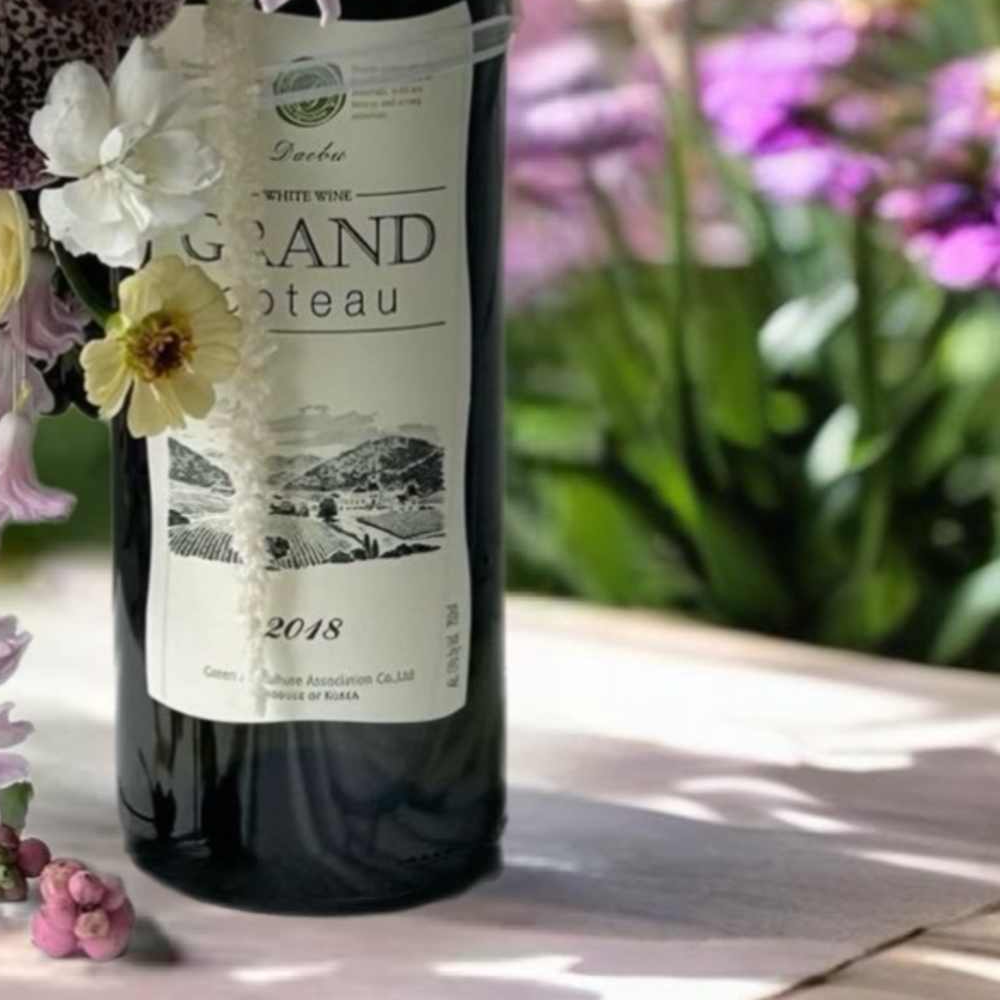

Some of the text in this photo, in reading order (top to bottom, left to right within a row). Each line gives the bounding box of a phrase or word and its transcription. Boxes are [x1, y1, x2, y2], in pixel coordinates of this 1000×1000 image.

[263, 189, 353, 202] WHITE WINE
[264, 616, 343, 641] 2018
[306, 673, 373, 687] Association
